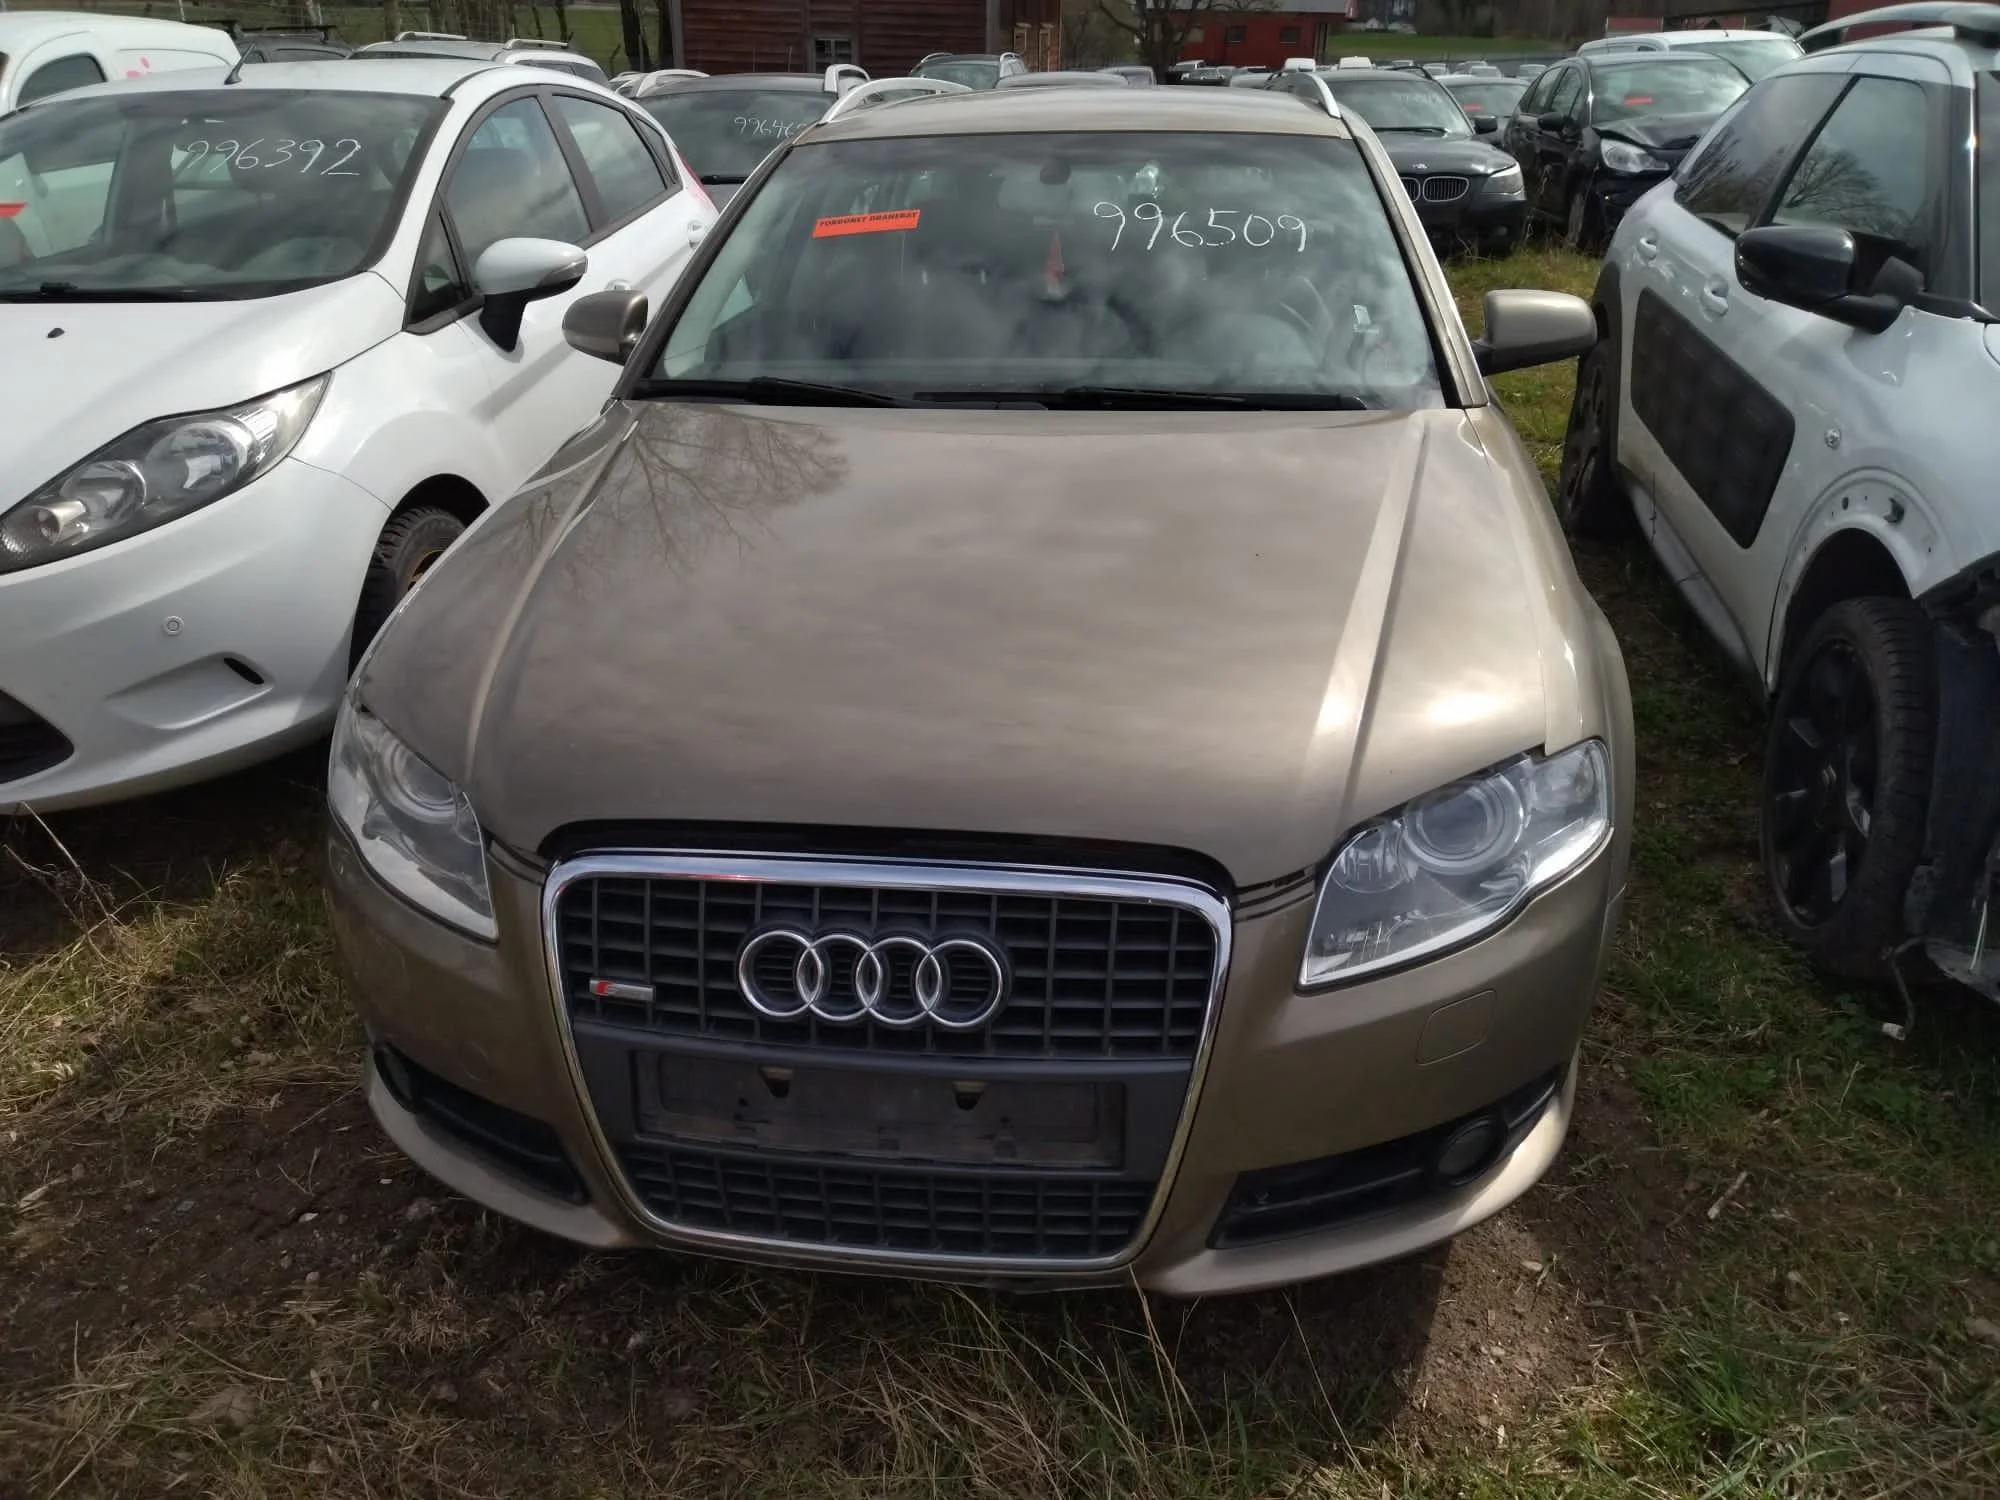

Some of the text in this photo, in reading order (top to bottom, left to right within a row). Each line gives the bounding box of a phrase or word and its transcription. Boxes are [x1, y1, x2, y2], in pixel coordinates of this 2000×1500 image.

[734, 115, 808, 140] 99646
[187, 137, 361, 176] 996392
[1094, 201, 1307, 252] 996509
